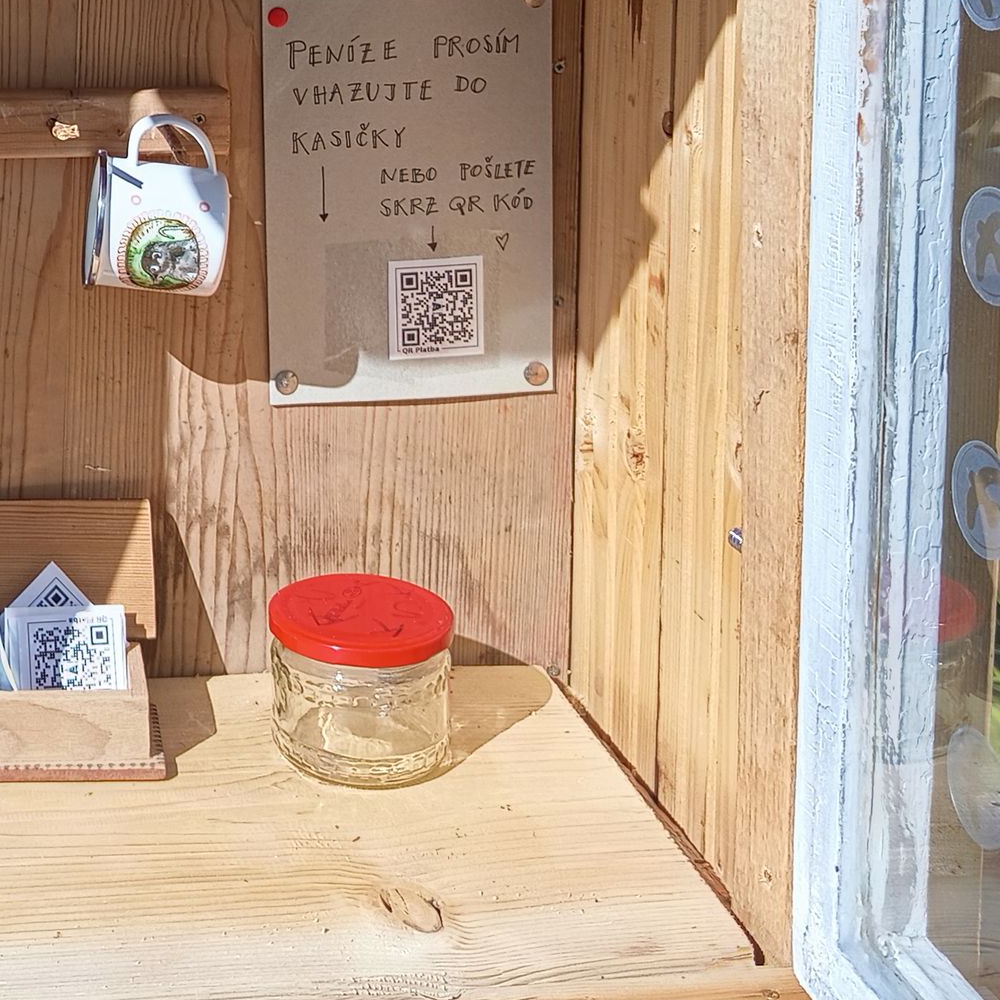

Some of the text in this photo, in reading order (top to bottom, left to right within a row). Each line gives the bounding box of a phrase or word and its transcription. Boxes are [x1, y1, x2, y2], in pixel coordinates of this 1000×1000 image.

[285, 28, 520, 70] PENÍZE PROSÍM
[292, 75, 487, 106] VHAZUJTE DO
[291, 122, 406, 156] KASIČKY
[380, 155, 537, 184] NEBO POŠLETE
[379, 187, 534, 217] SKRZ QR KÓD
[402, 347, 413, 355] QR
